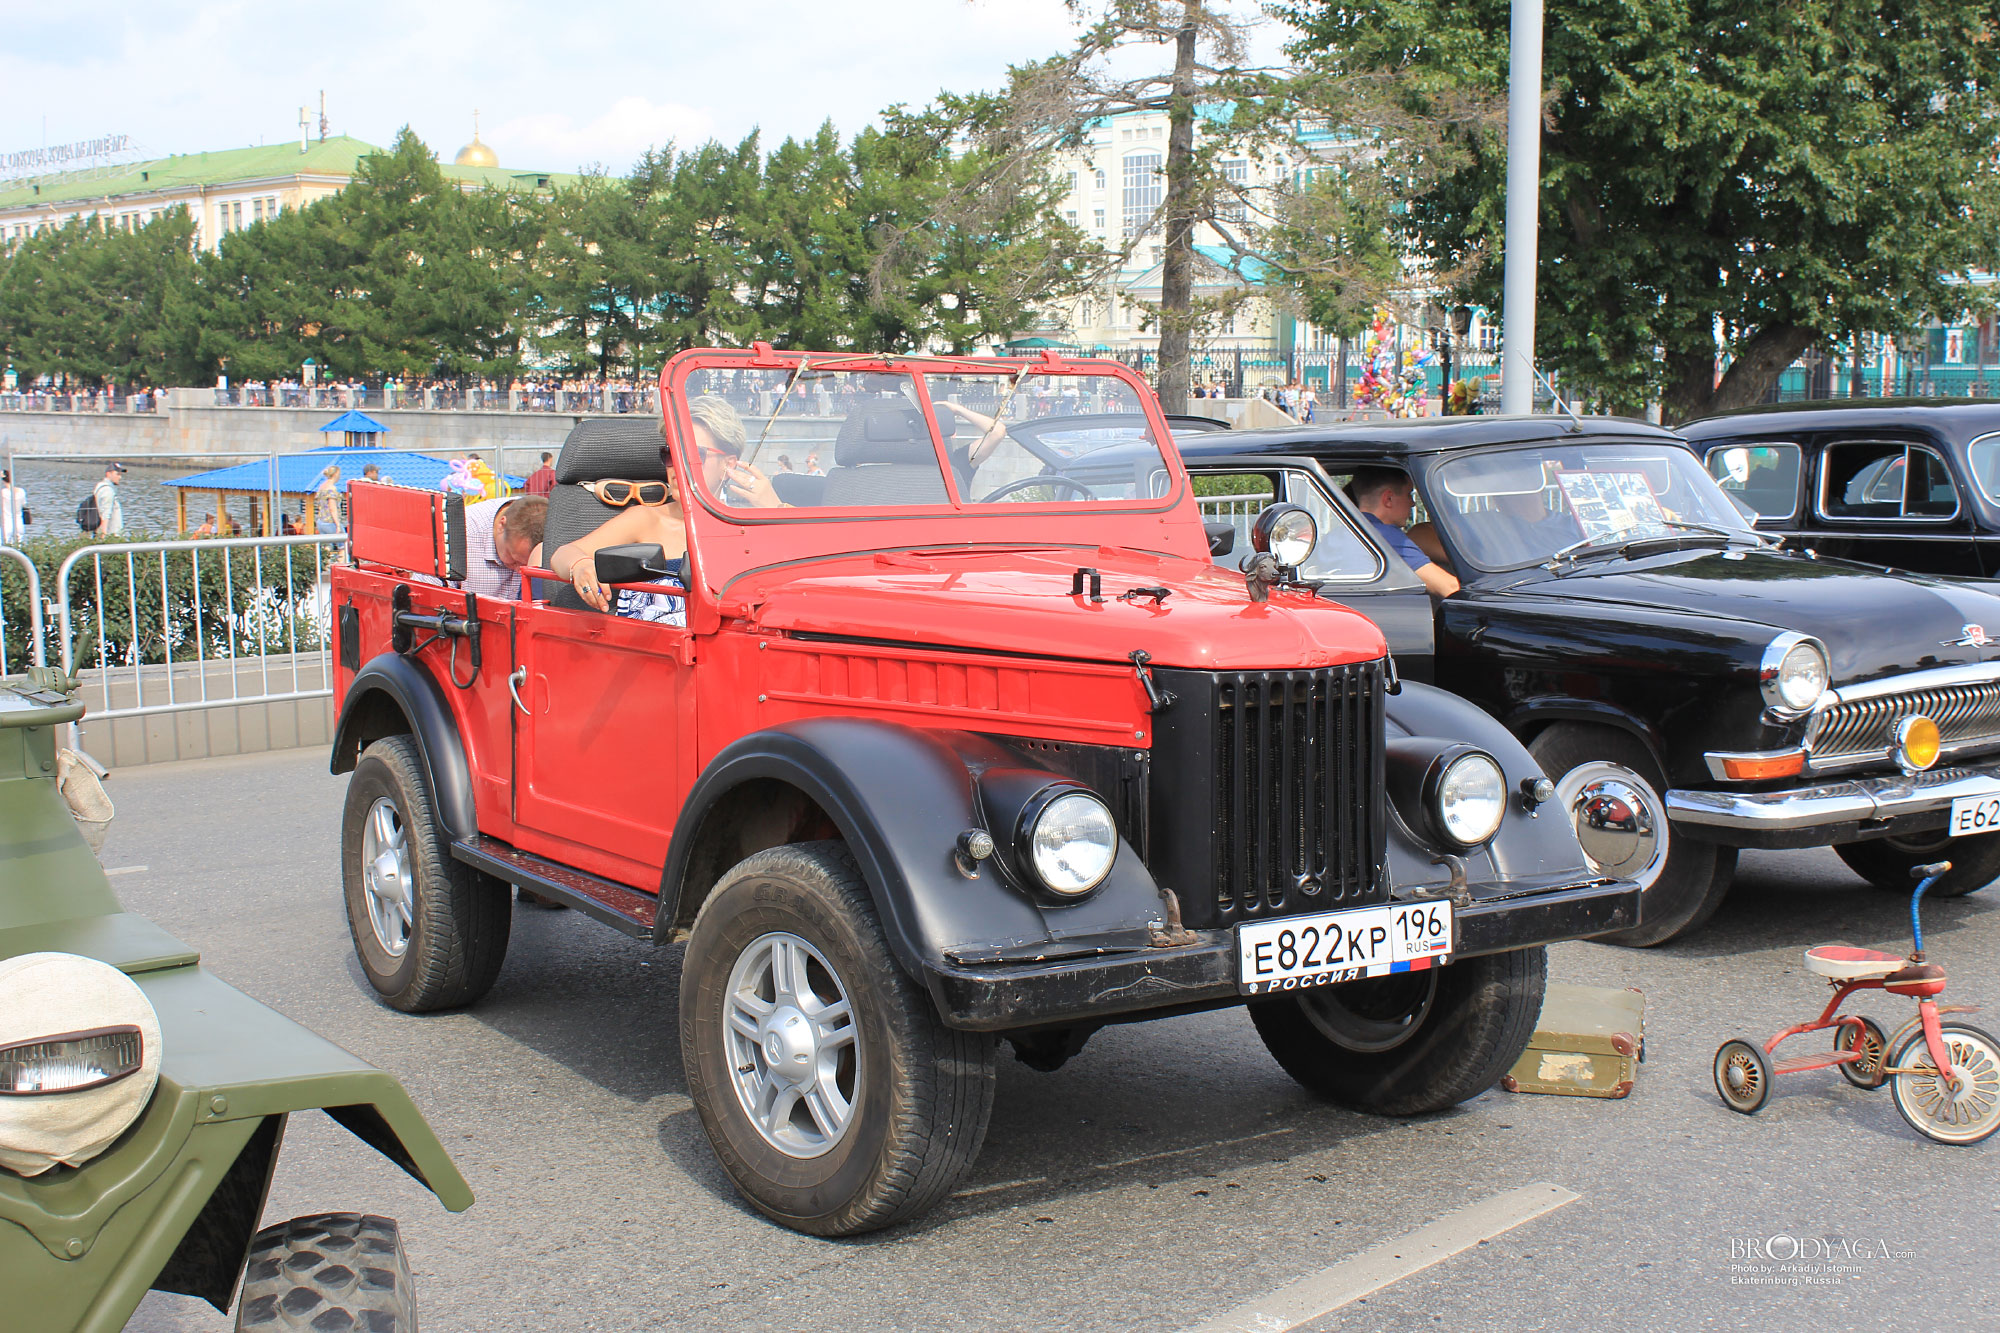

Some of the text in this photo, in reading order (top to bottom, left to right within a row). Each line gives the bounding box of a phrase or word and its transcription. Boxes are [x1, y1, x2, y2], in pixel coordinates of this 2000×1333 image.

[1396, 906, 1442, 941] 196
[1406, 940, 1429, 954] RUS
[1267, 967, 1360, 993] РОССИЯ
